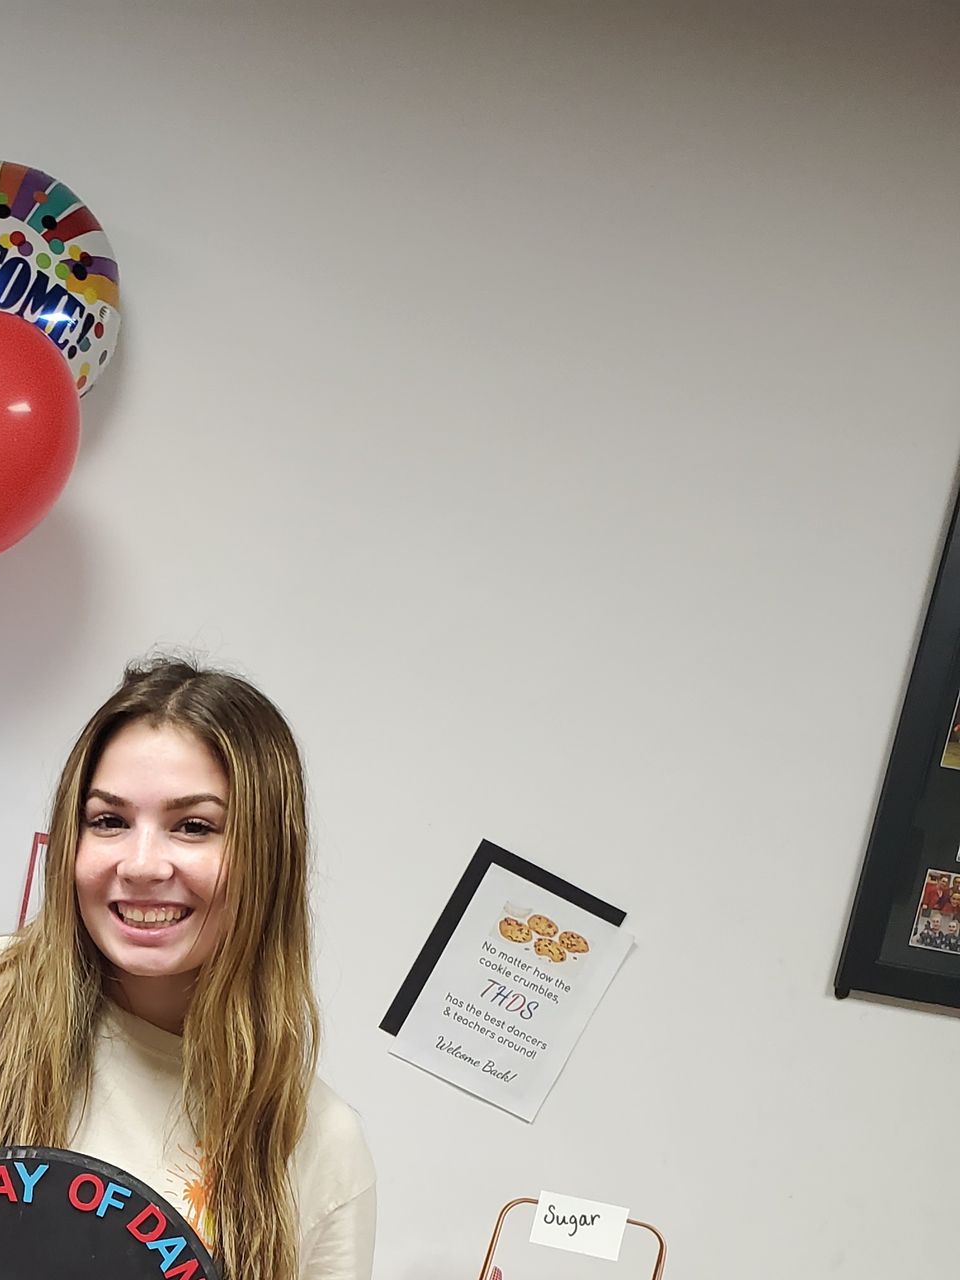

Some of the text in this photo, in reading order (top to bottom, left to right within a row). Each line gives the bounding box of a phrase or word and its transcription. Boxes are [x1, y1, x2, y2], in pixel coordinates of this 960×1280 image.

[478, 956, 560, 1004] cookie crumbles,
[481, 940, 571, 993] No matter how the
[444, 992, 548, 1051] has the best dancers
[480, 978, 539, 1020] THDS
[442, 1006, 537, 1060] & teachers around!
[435, 1035, 518, 1084] Welcome Back!
[68, 1173, 132, 1218] OF
[543, 1204, 601, 1237] Sugar
